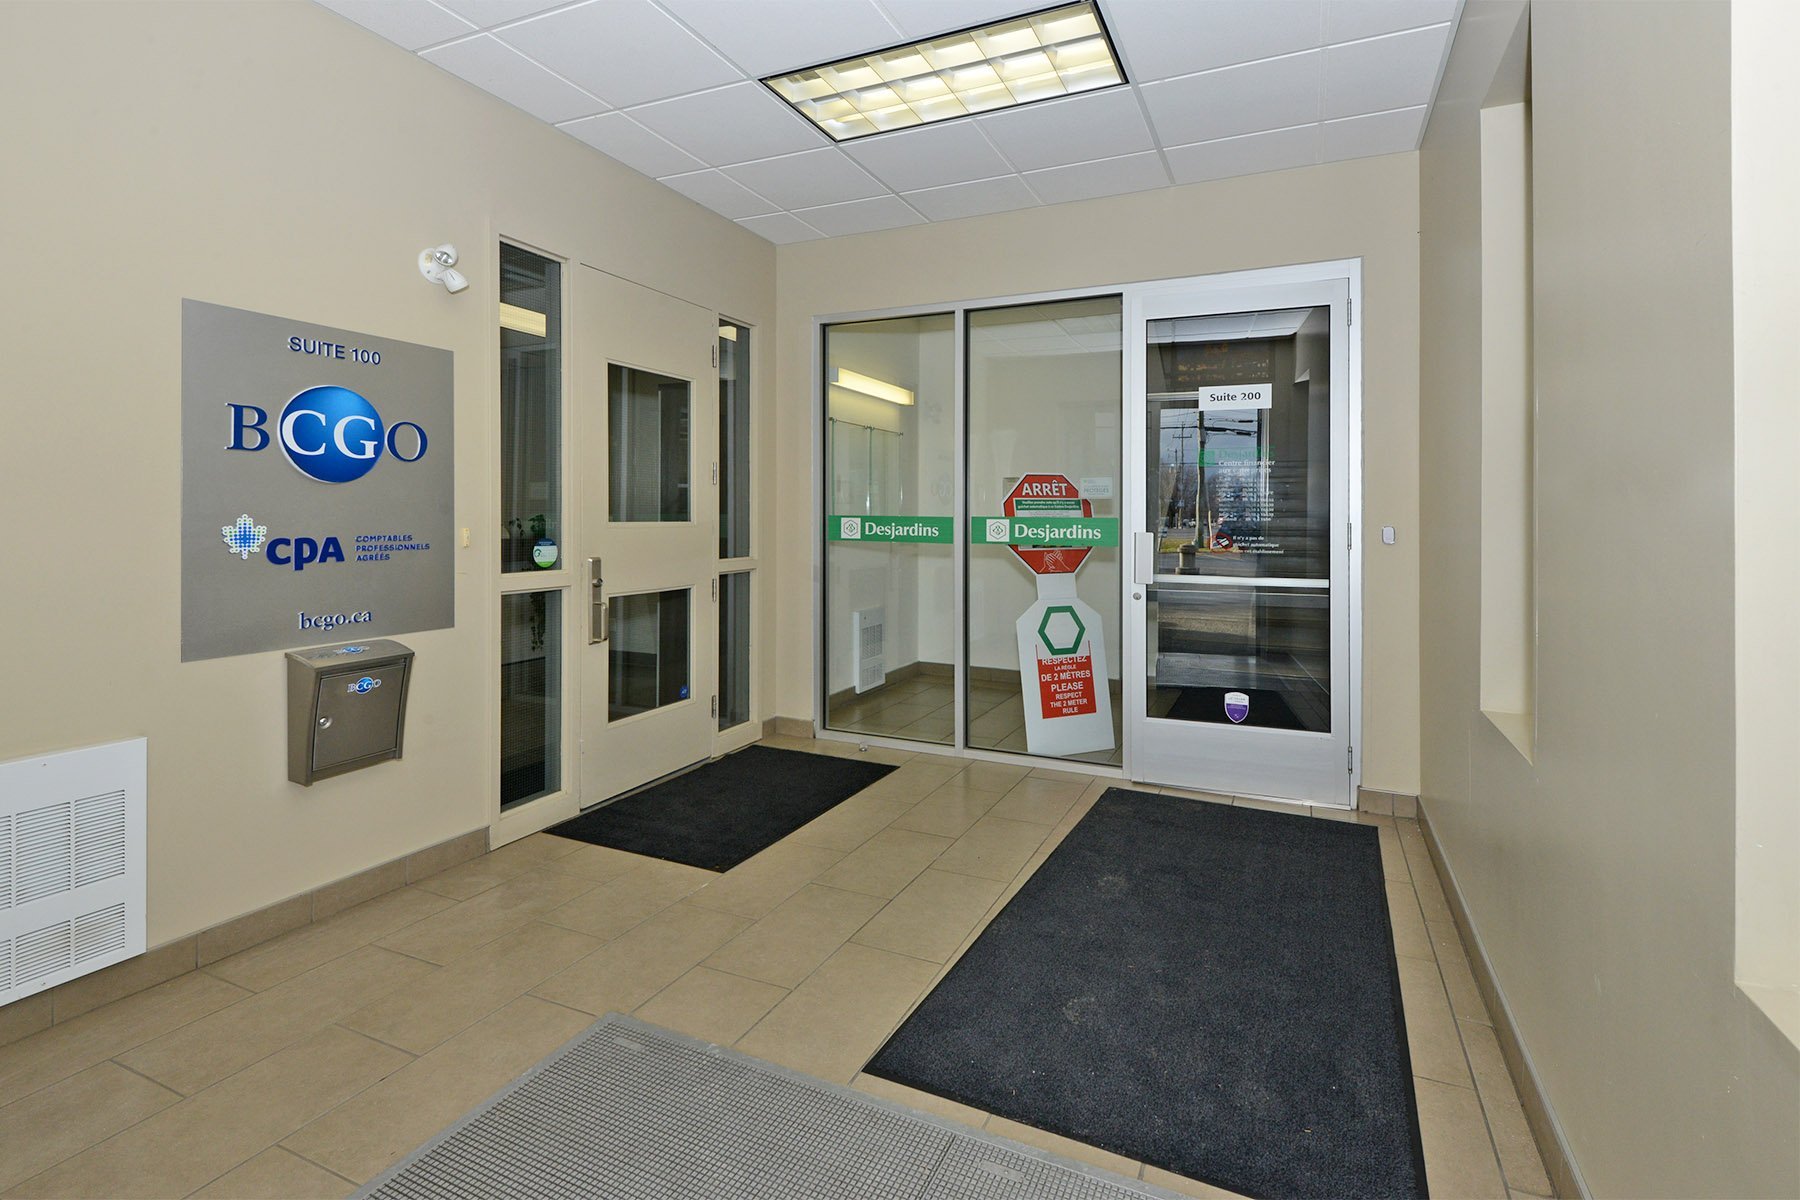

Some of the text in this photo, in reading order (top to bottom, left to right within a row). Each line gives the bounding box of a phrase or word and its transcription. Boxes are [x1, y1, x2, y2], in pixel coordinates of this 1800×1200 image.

[288, 336, 381, 365] SUITE 100
[1210, 391, 1261, 402] Suite 200
[1022, 480, 1067, 496] ARRÊT
[865, 522, 939, 539] Desjardins
[1014, 524, 1102, 543] Desjardins
[356, 535, 412, 543] COMPTABLES
[356, 543, 430, 551] PROFESSIONNELS
[356, 553, 390, 561] AGRÉÉS
[298, 609, 372, 631] bcgo.ca
[1042, 656, 1087, 665] RESPECTEZ
[1041, 674, 1052, 682] DE
[1060, 670, 1091, 680] MÈTRES
[1051, 681, 1084, 692] PLEASE
[1055, 692, 1082, 700] RESPECT
[1068, 698, 1088, 706] METER
